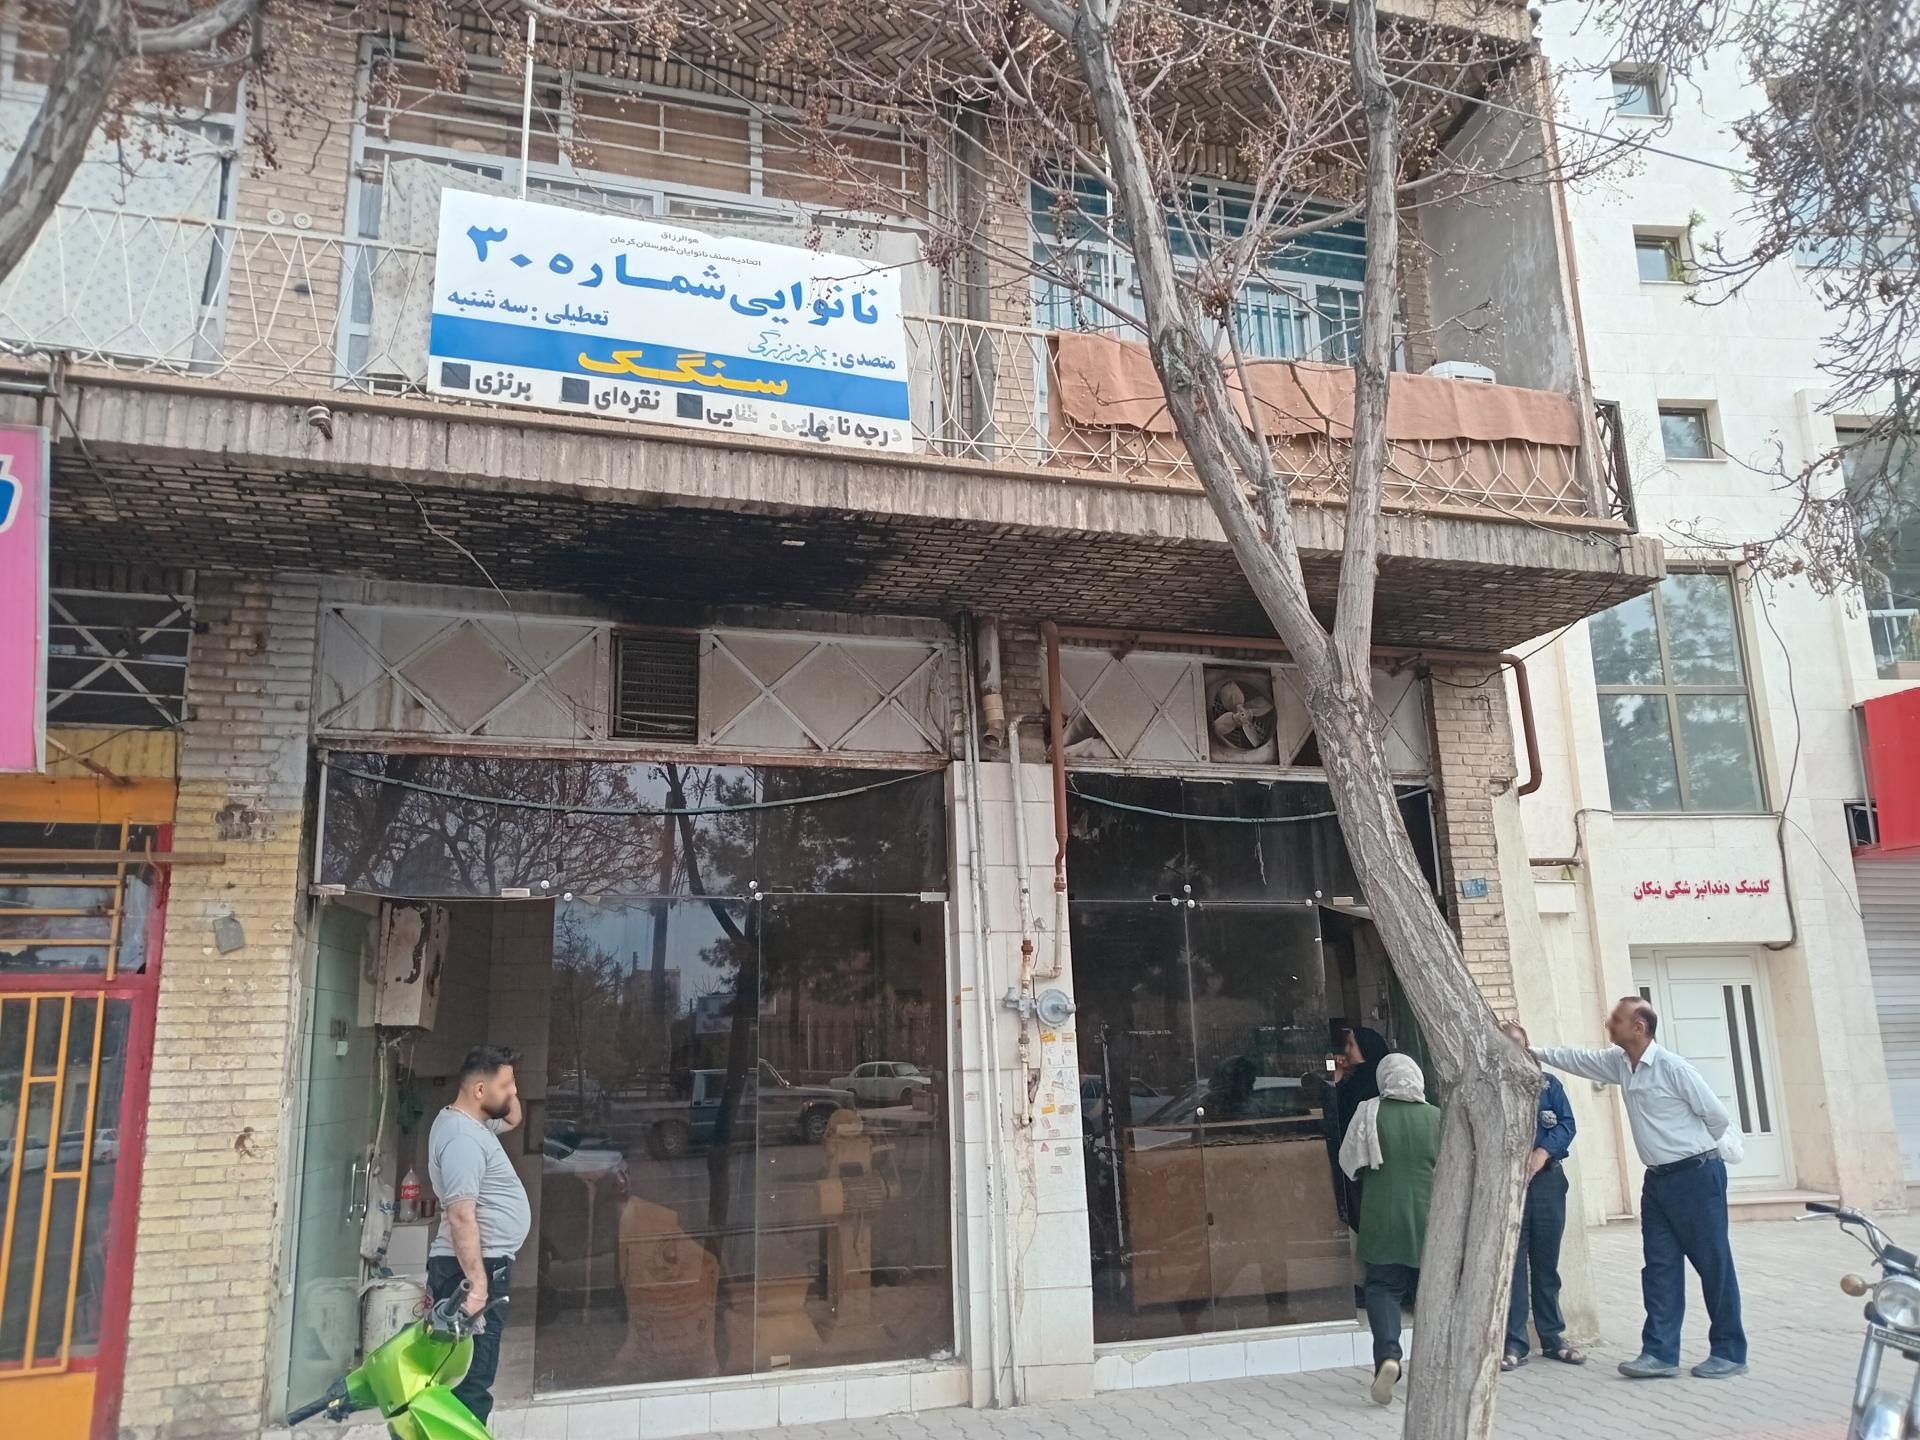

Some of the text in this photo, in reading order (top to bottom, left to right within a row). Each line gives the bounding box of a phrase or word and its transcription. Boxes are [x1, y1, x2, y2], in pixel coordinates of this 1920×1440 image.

[609, 237, 762, 266] اتحادیه صنف نانوایان شهرستان کرمان
[548, 252, 726, 300] شماره
[447, 289, 496, 313] شنبه
[729, 281, 878, 326] نانوایی
[475, 370, 532, 401] برنزی
[577, 349, 789, 396] سنگک
[1633, 880, 1662, 900] نیکان
[1735, 879, 1770, 897] کلینیک
